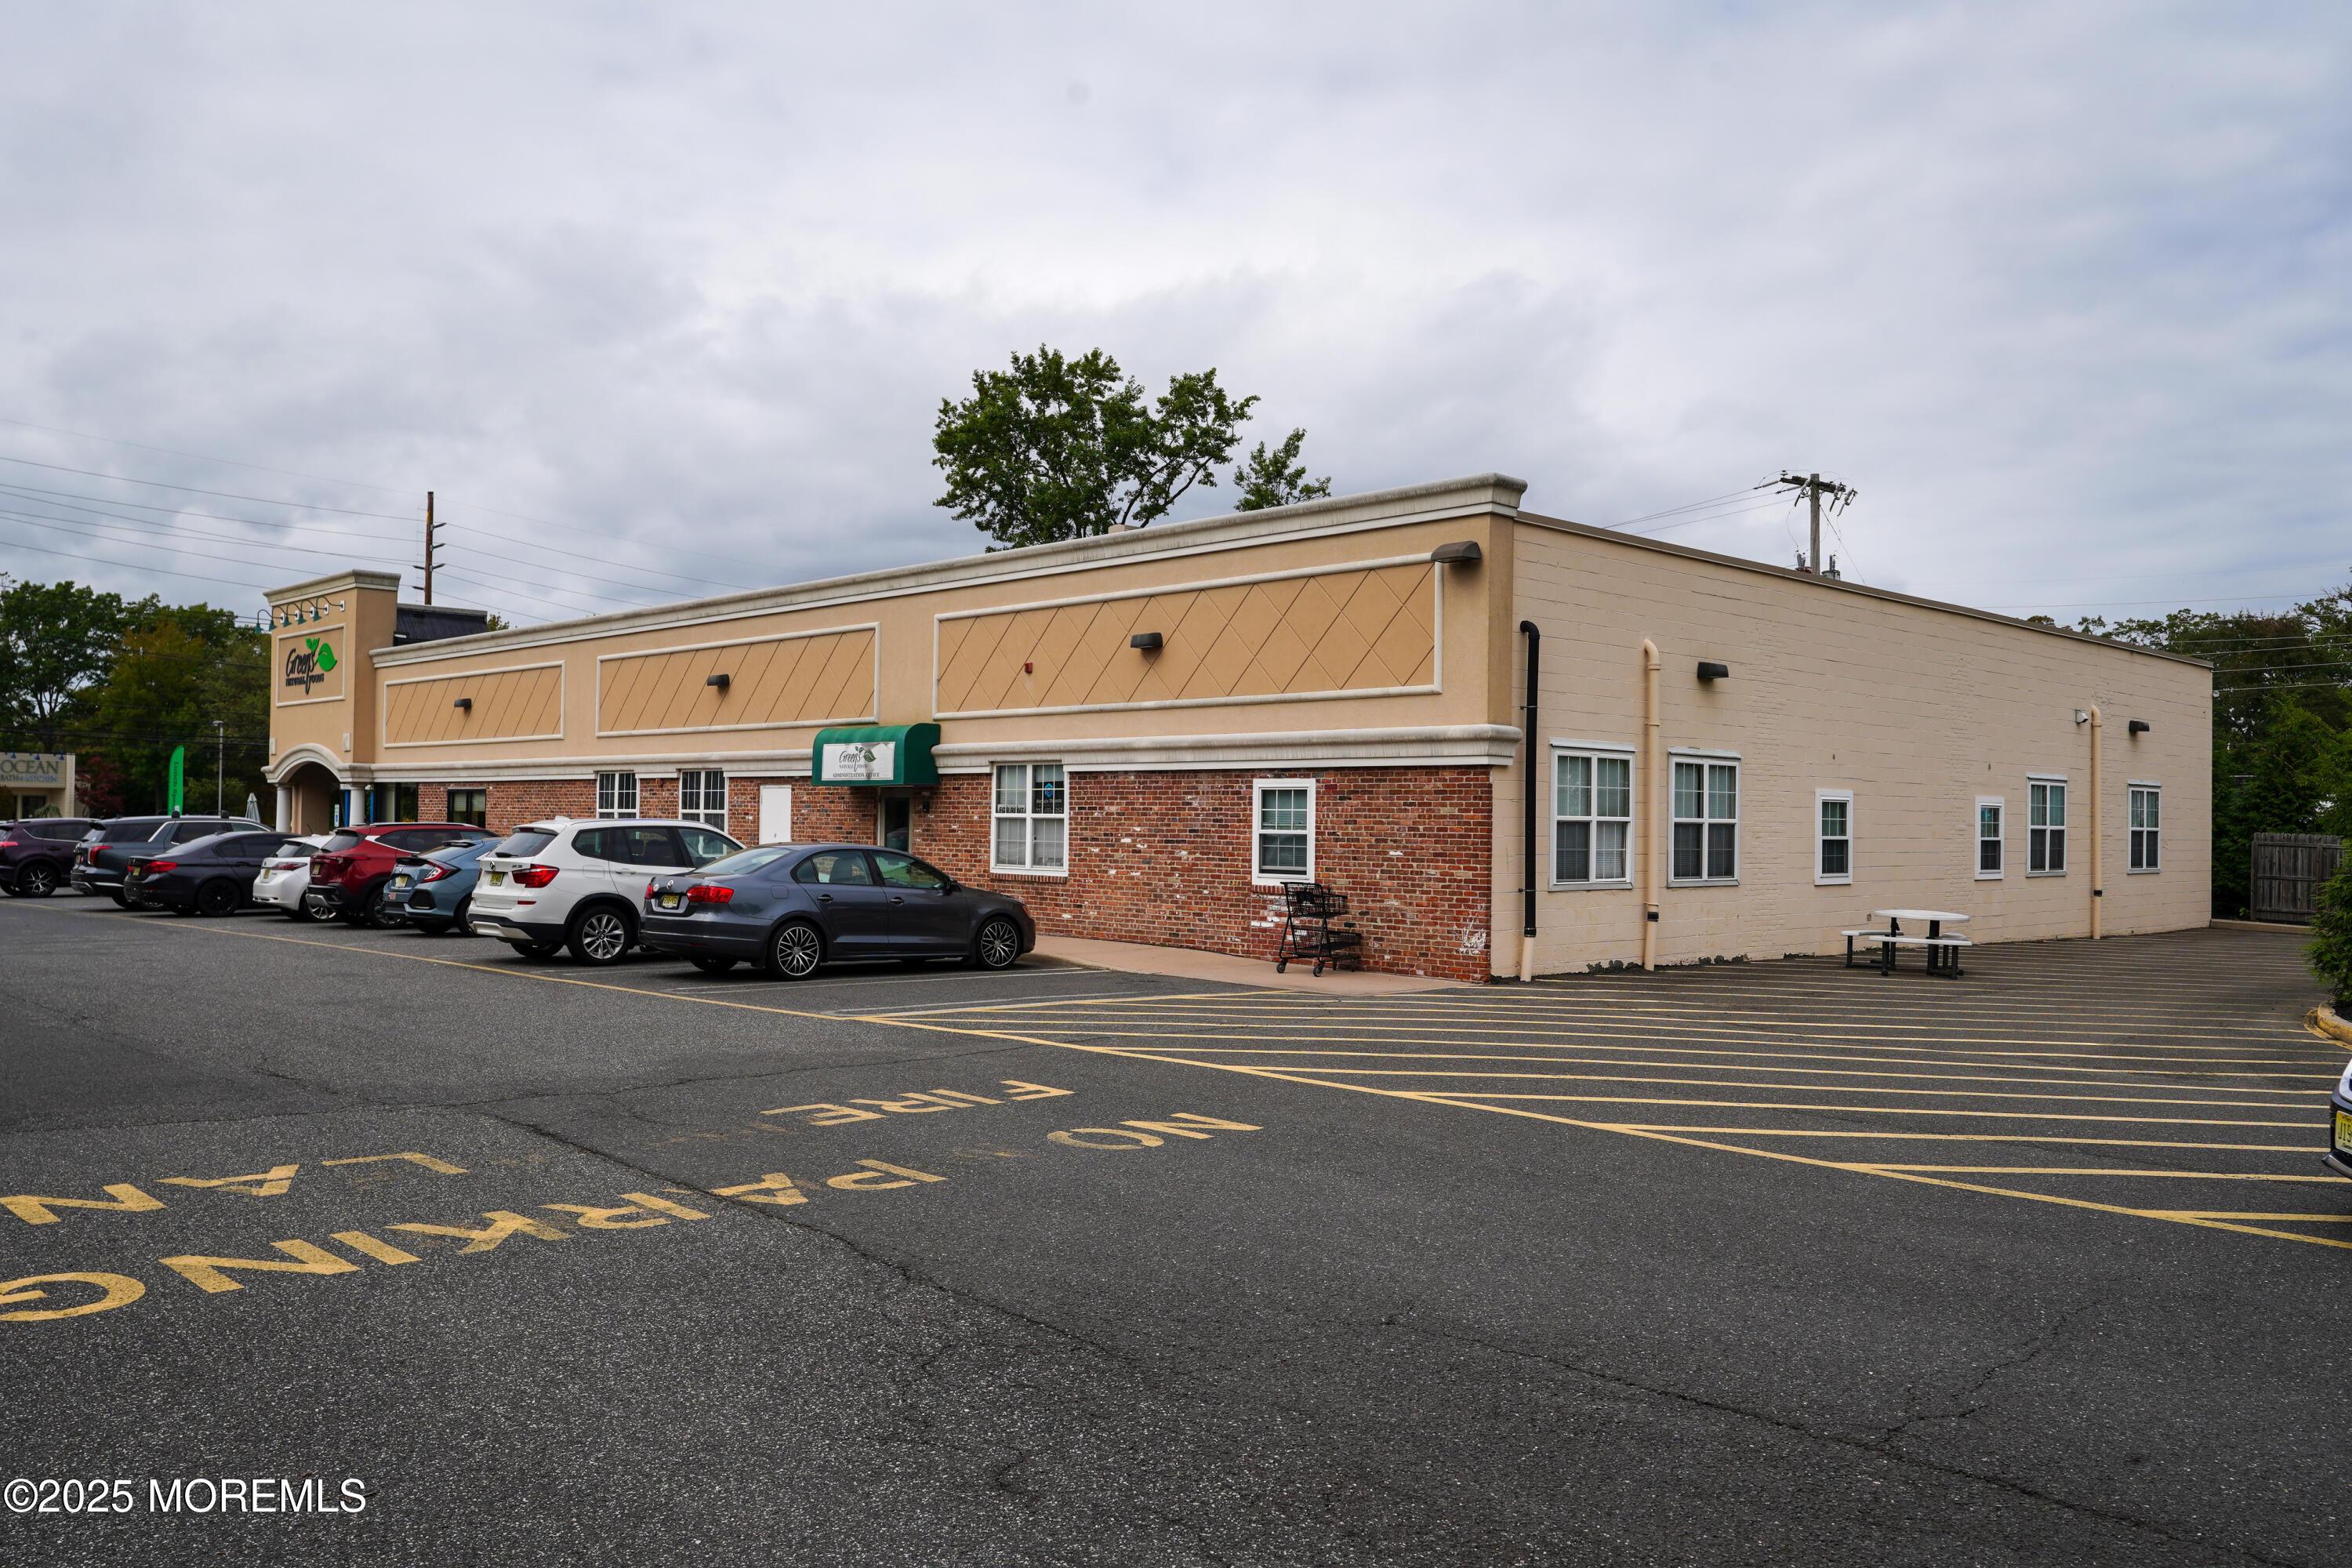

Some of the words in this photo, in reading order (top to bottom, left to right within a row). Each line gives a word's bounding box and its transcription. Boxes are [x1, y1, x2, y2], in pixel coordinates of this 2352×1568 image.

[1, 760, 59, 774] OCEAN
[760, 1080, 1077, 1127] FIRE
[1047, 1112, 1263, 1150] NO
[0, 1151, 469, 1226] LAN
[0, 1159, 948, 1323] PARKING
